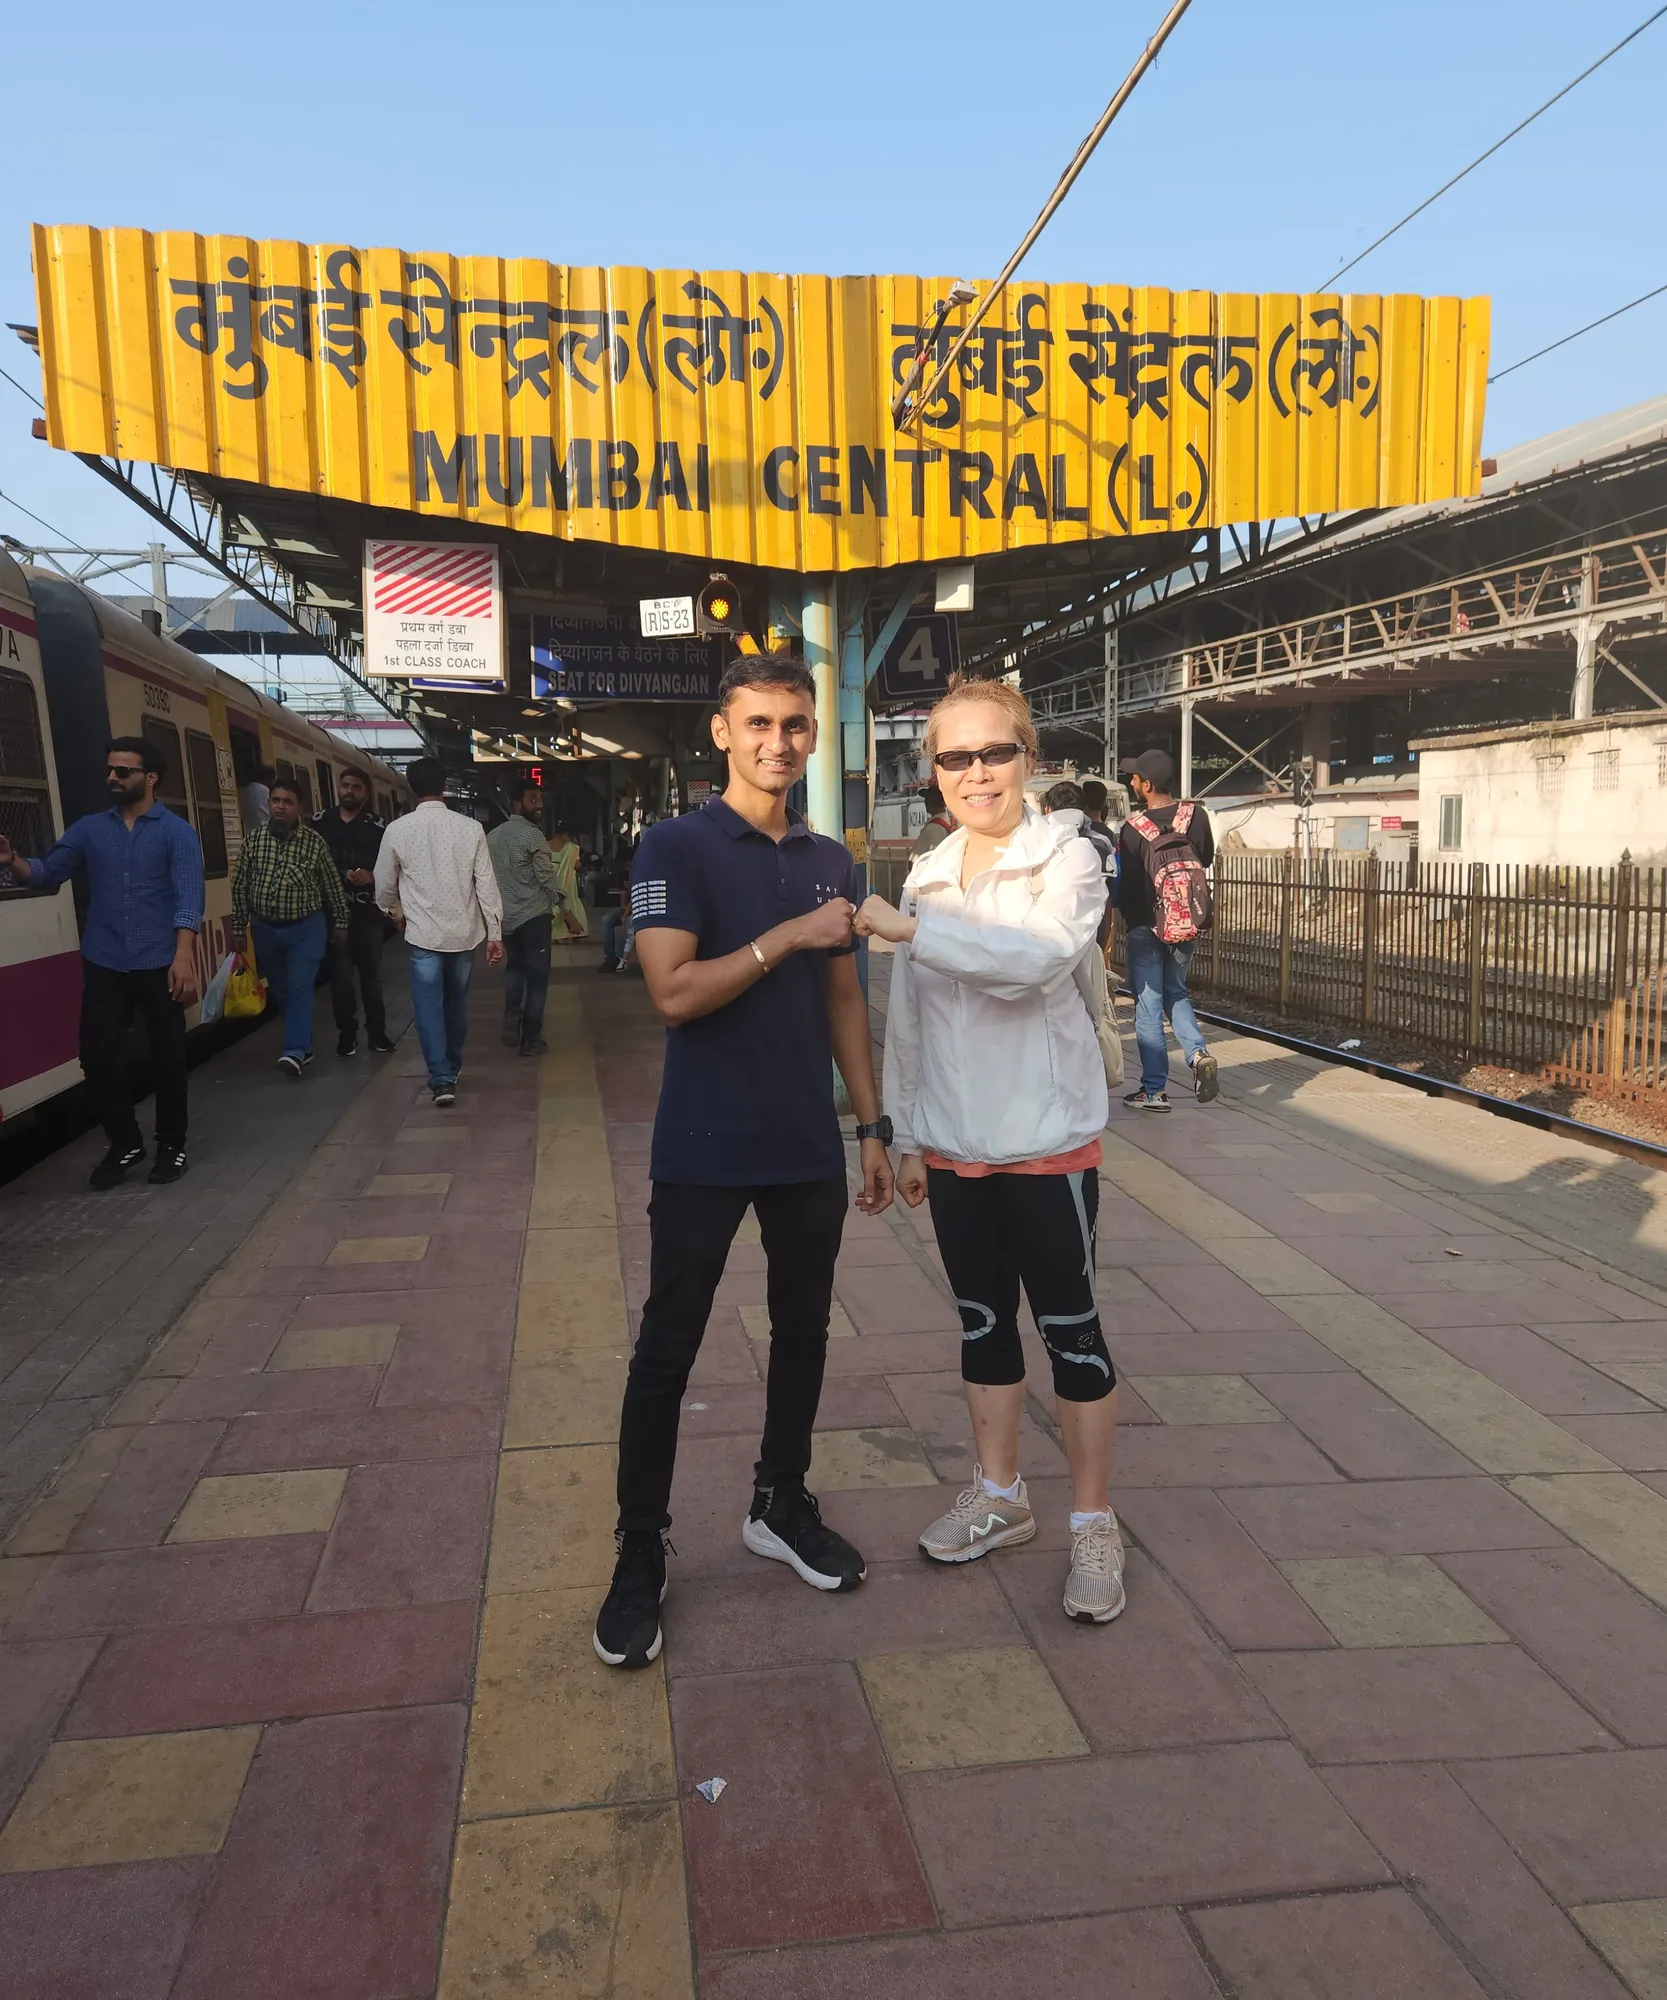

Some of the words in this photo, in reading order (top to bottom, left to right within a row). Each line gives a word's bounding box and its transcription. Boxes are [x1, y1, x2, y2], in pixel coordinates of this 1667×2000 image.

[169, 250, 373, 400] मुंबई
[891, 293, 1054, 430] मुंबई
[411, 429, 710, 512] MUMBAI
[763, 444, 1089, 522] CENTRAL
[1108, 441, 1209, 533] (L.)
[400, 621, 425, 633] प्रथम
[428, 620, 444, 634] वर्ग
[448, 624, 467, 635] डबा
[645, 609, 690, 634] (R)S-23
[395, 639, 422, 651] पहला
[424, 637, 443, 652] दर्जा
[447, 638, 474, 652] डिब्बा
[547, 638, 613, 661] दिव्यांगजन
[618, 640, 630, 662] के
[635, 642, 662, 664] बैठने
[667, 642, 680, 663] के
[684, 642, 709, 667] लिए
[898, 627, 940, 680] 4
[384, 655, 400, 666] 1st
[405, 656, 442, 667] CLASS
[447, 658, 486, 669] COACH
[548, 671, 584, 691] SEAT
[588, 671, 615, 692] FOR
[620, 673, 709, 694] DIVYANGJAN
